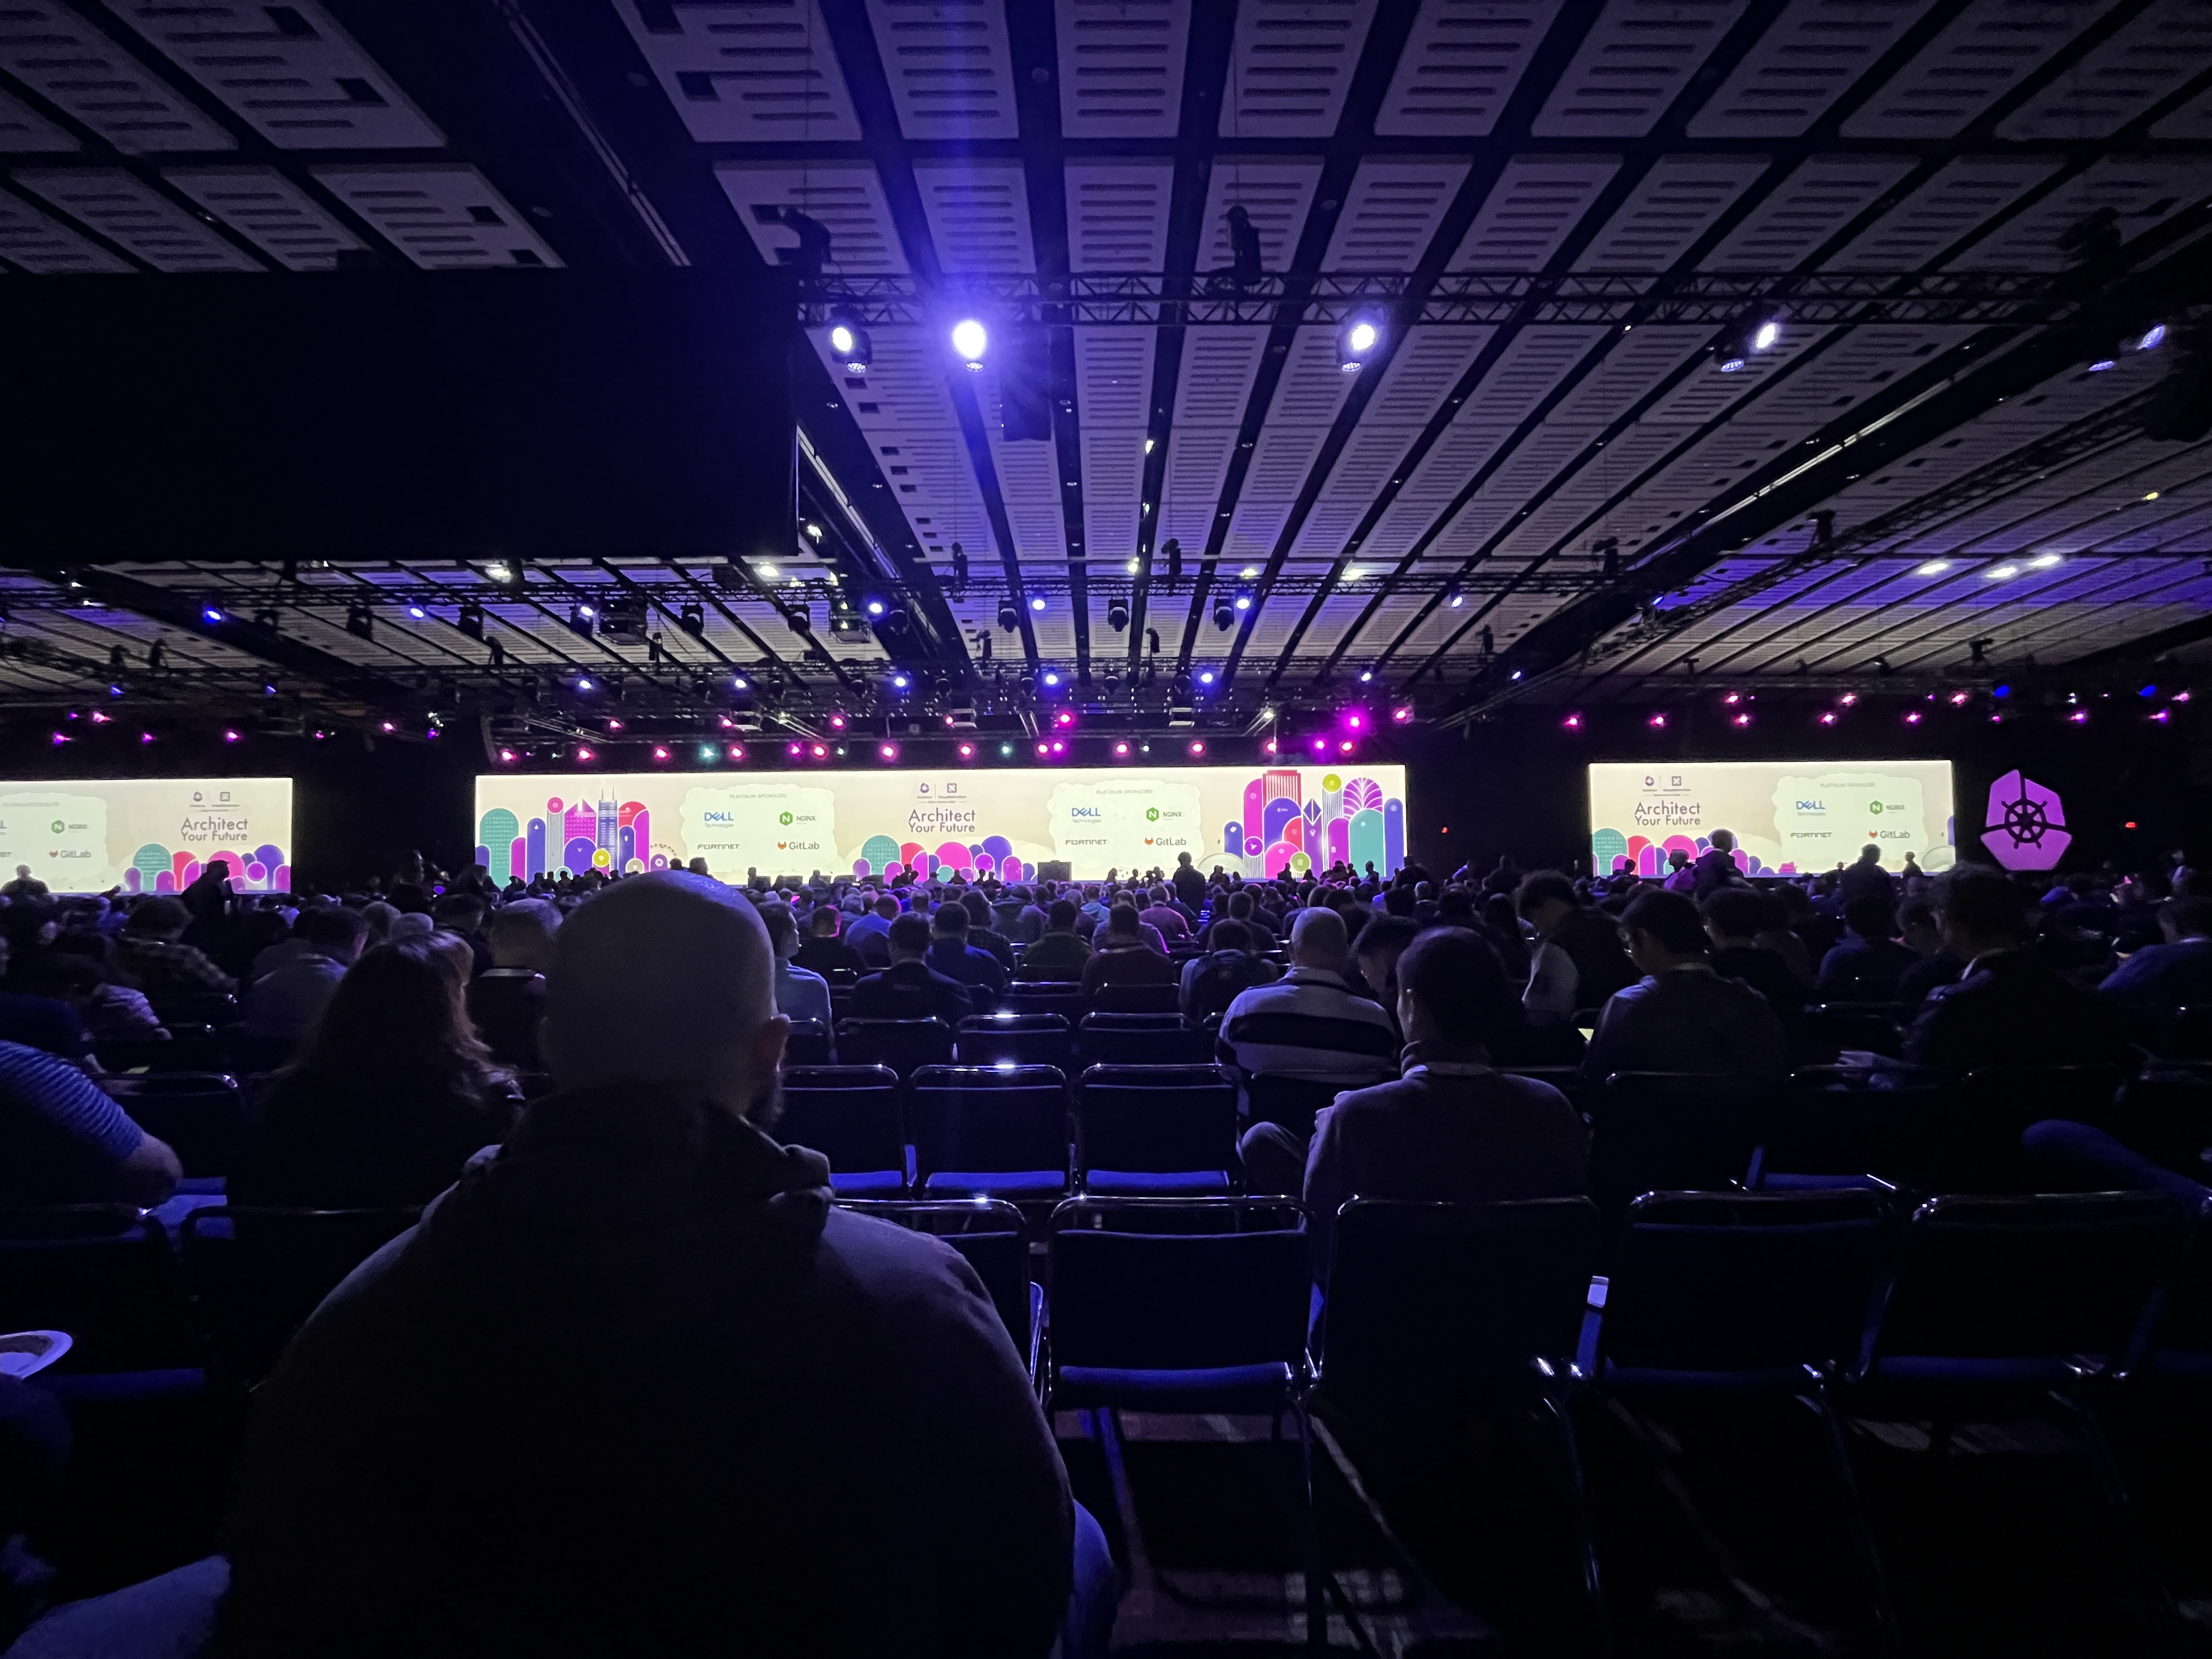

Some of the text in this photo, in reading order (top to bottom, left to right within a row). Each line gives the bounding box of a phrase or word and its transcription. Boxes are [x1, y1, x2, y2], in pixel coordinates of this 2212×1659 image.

[1635, 800, 1701, 815] Architect
[1796, 800, 1826, 810] DELL
[704, 812, 734, 821] DELL
[909, 807, 975, 822] Architect
[1071, 807, 1101, 816] DELL
[180, 816, 248, 830] Architect
[1635, 815, 1701, 826] Your Future
[909, 822, 975, 833] Your Future
[181, 830, 247, 841] Your Future
[1880, 830, 1911, 839] GitLab
[789, 841, 820, 850] GitLab
[1156, 837, 1187, 845] GitLab
